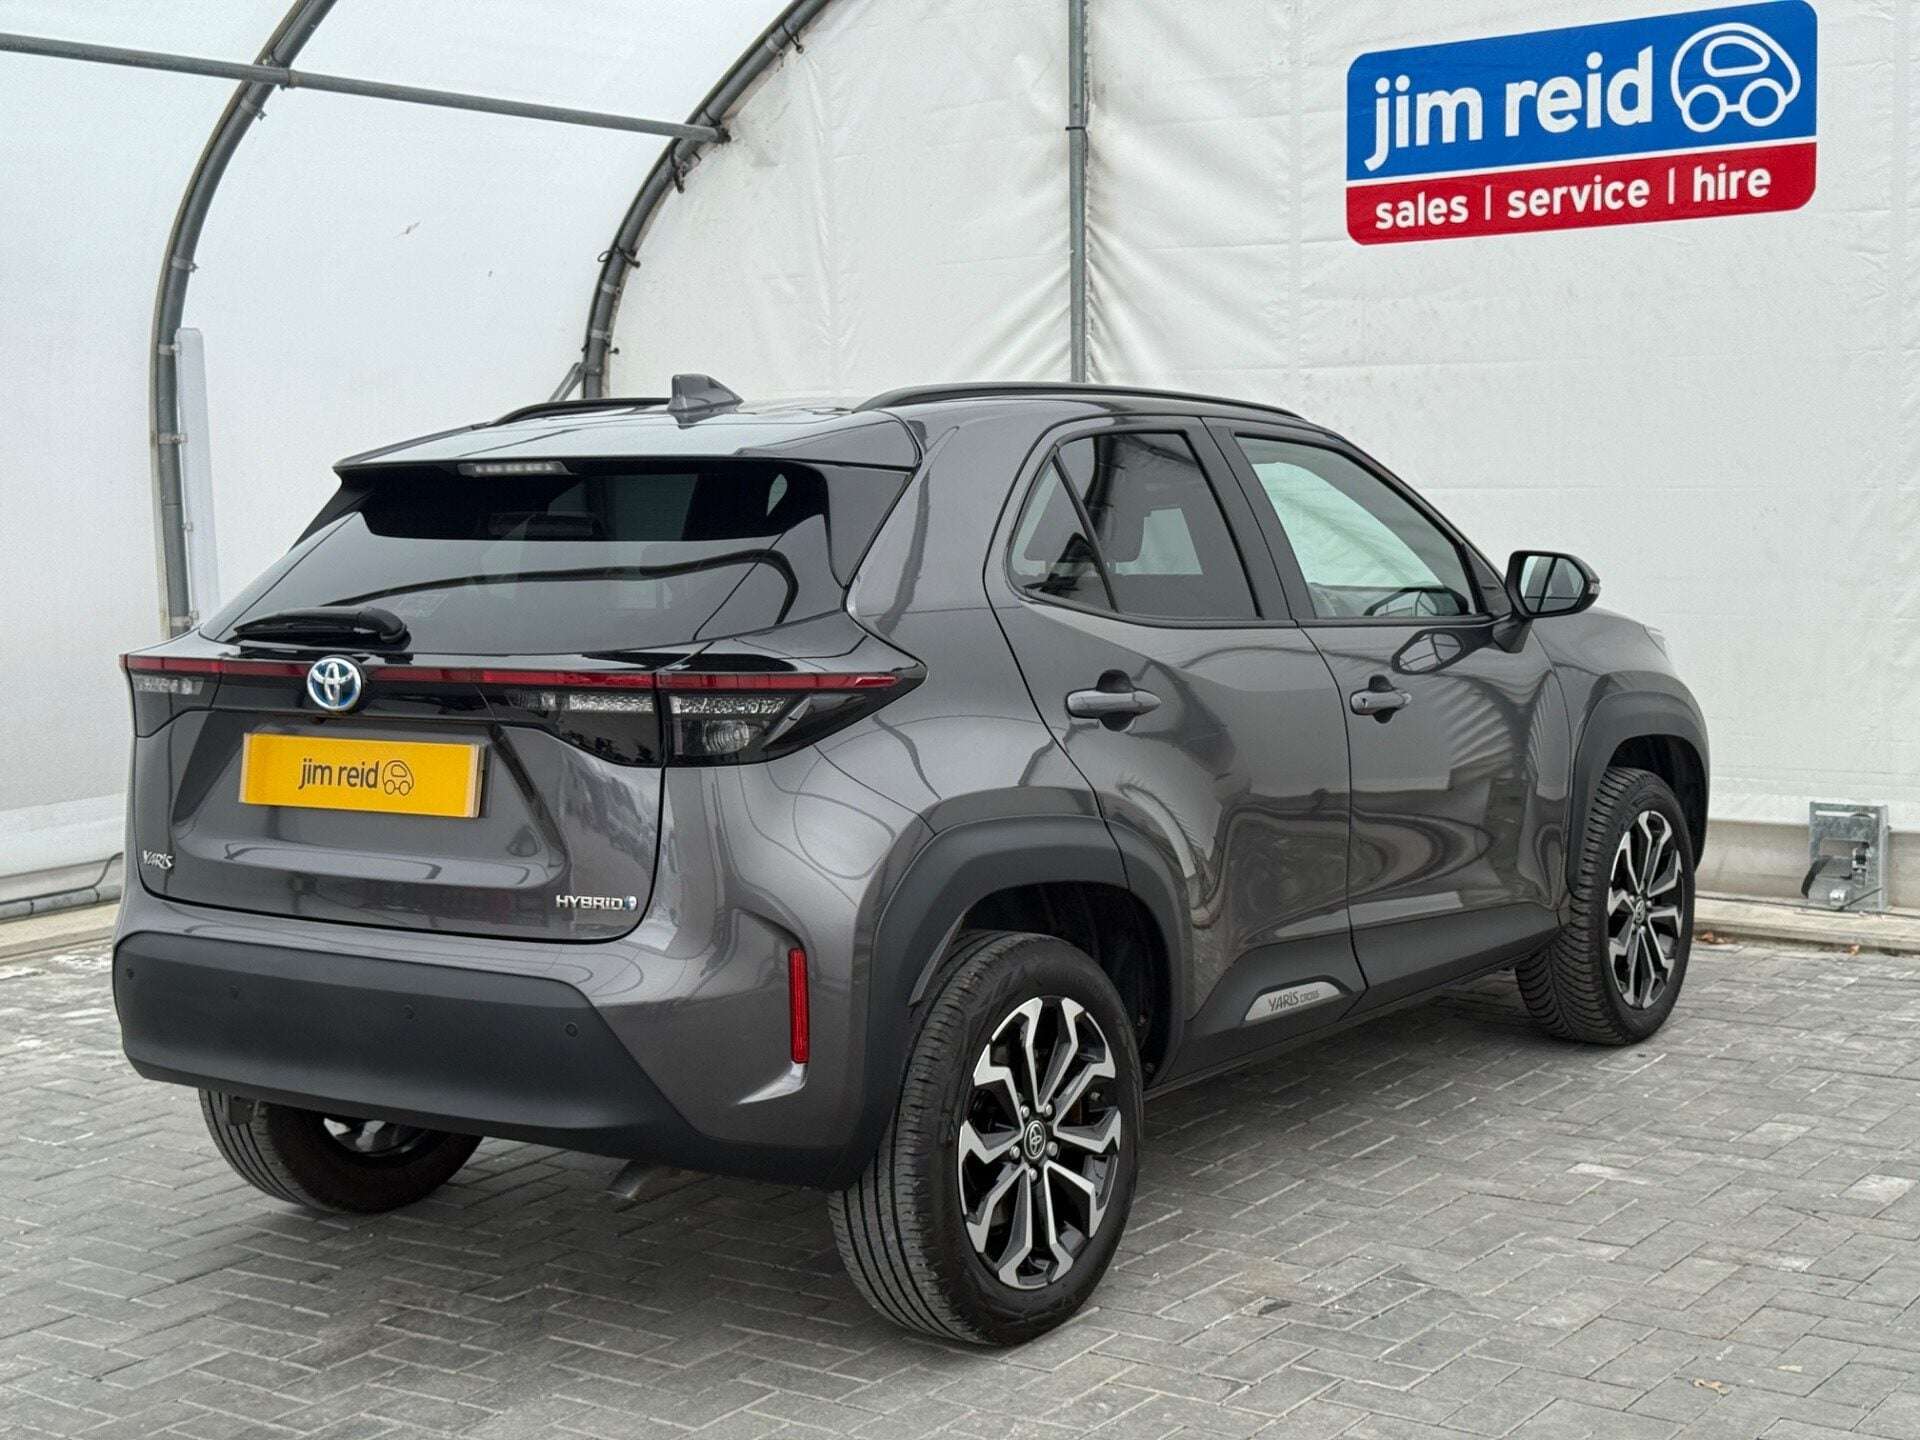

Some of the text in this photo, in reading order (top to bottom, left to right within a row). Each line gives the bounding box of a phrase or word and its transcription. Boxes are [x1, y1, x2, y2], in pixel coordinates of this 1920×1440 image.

[1364, 45, 1653, 172] jim reid
[1375, 163, 1771, 230] sales service hire
[298, 758, 379, 790] jim reid
[555, 895, 624, 910] HYBRID
